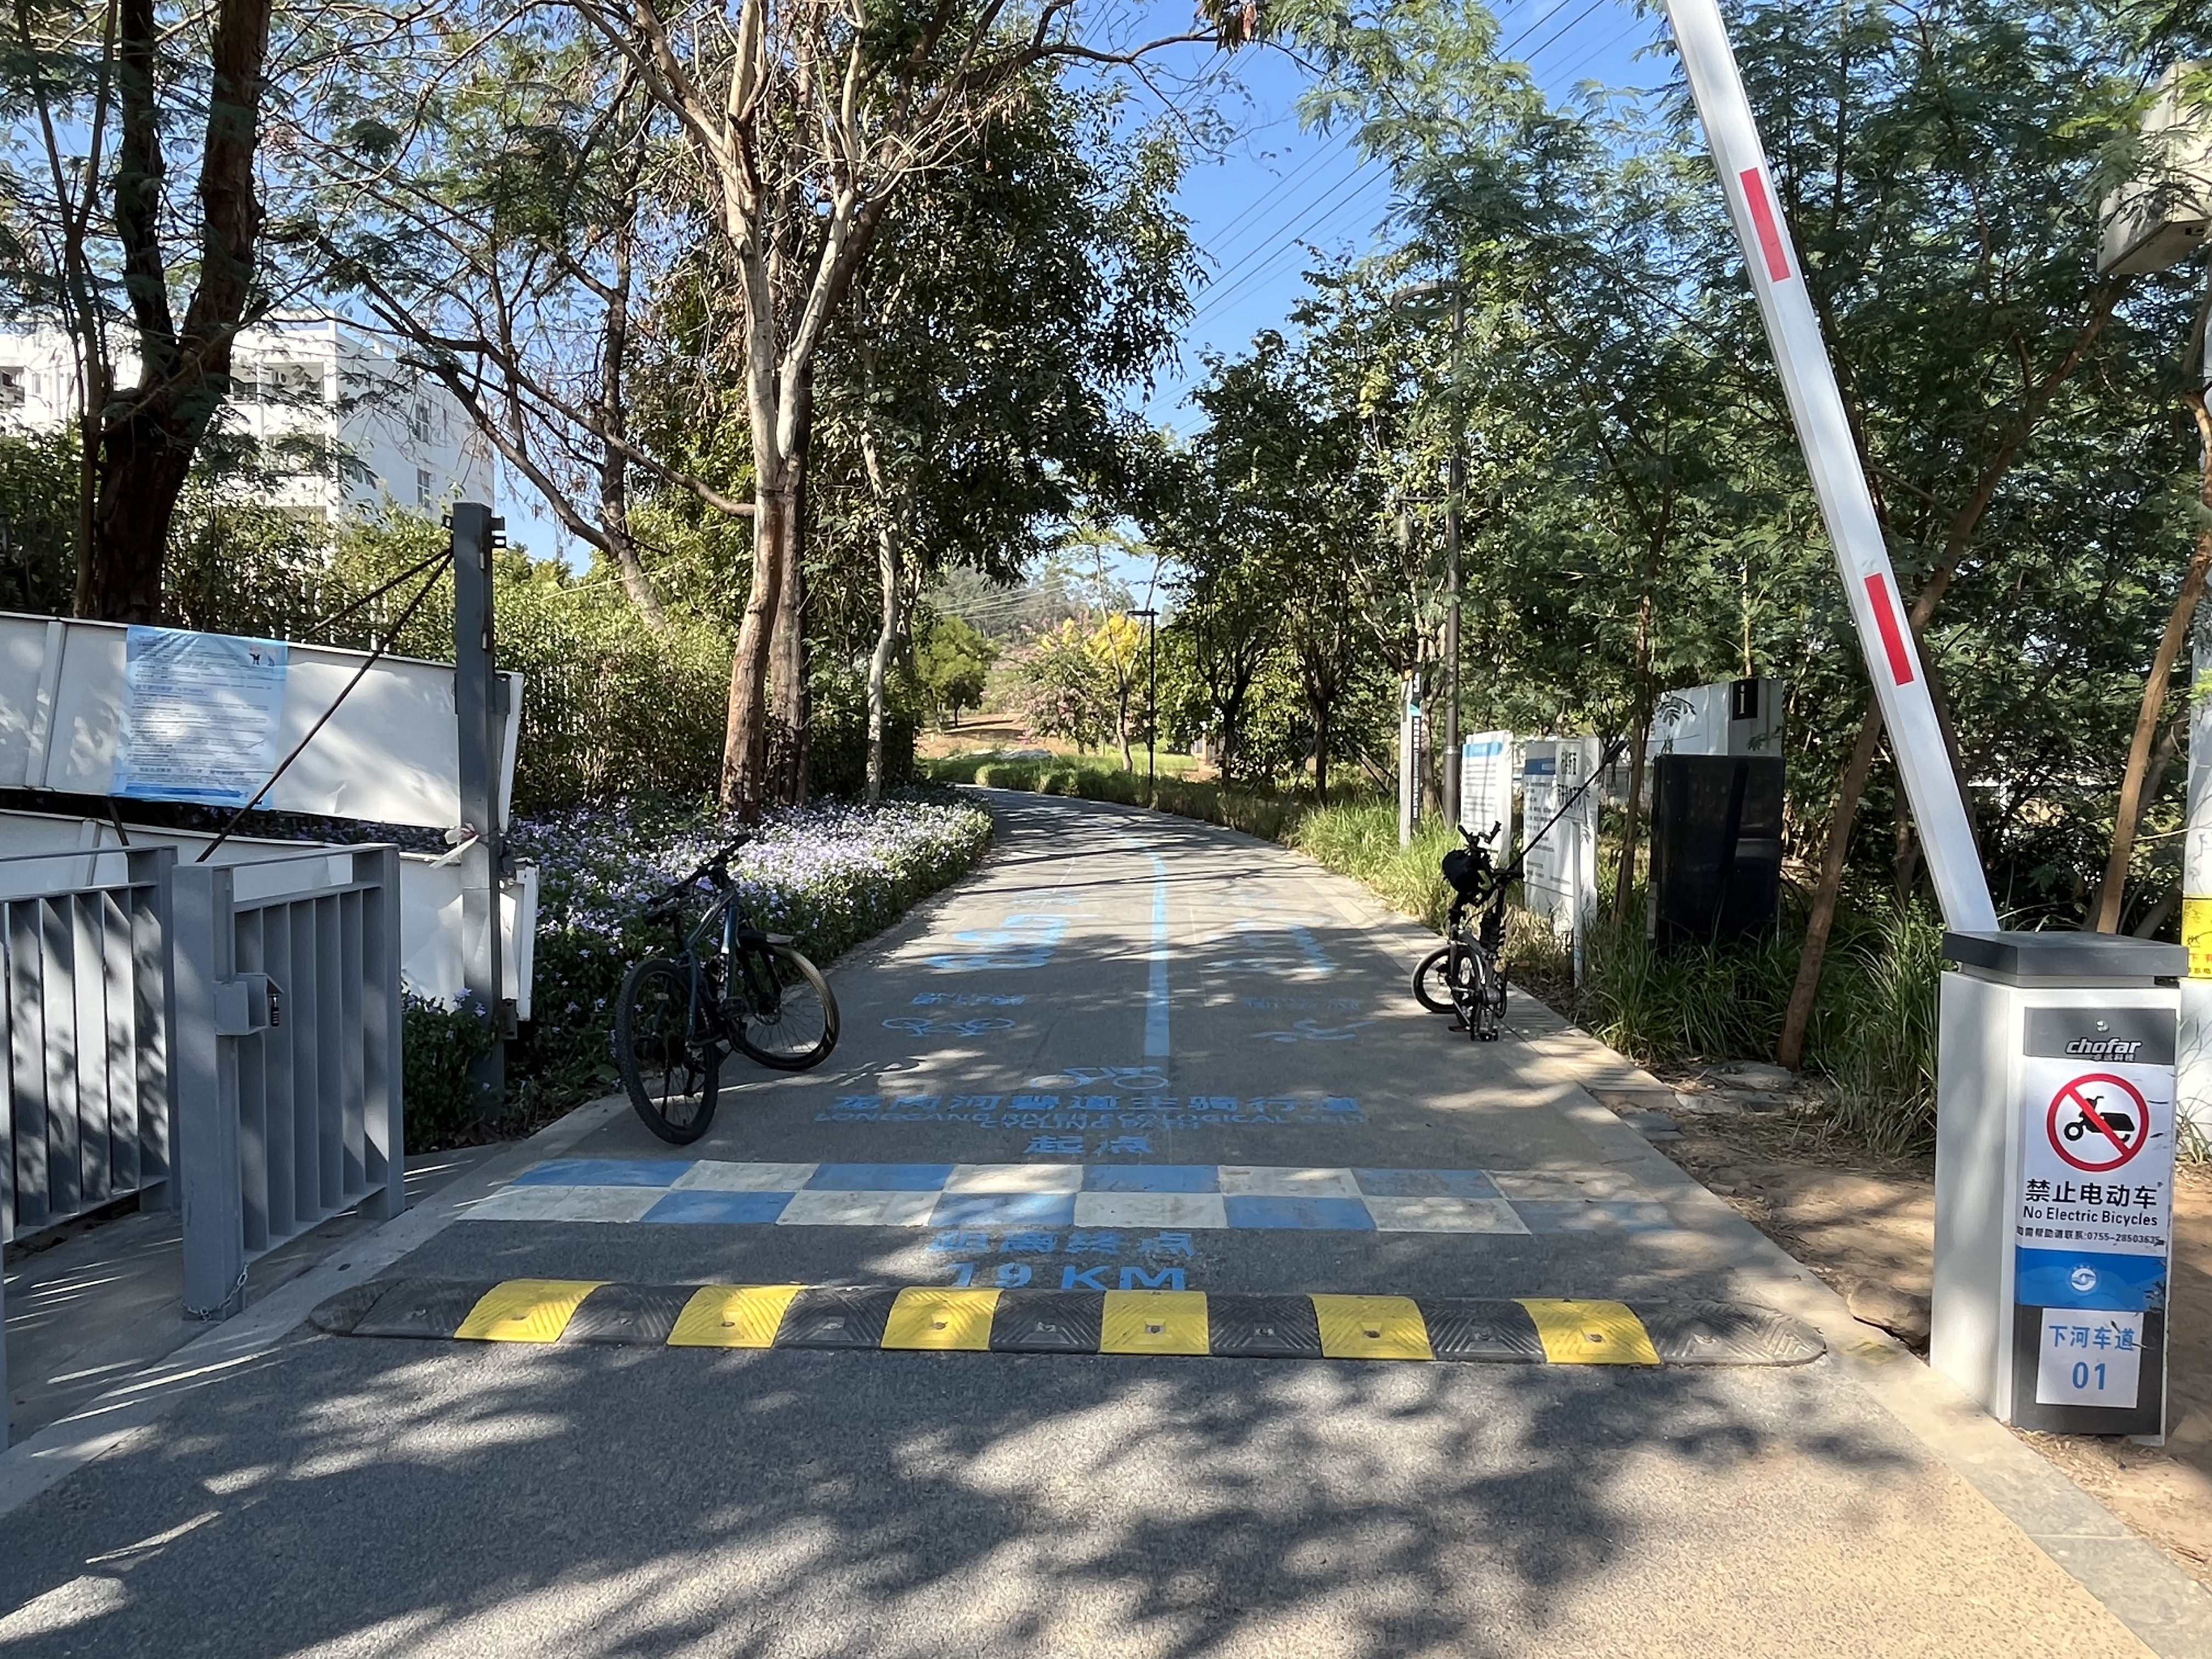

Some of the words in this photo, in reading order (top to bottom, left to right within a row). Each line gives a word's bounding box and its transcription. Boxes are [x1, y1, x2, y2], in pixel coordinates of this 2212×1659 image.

[2066, 1037, 2142, 1053] chofar
[1024, 1135, 1153, 1155] 起点
[2025, 1178, 2157, 1209] 禁止电动车
[2023, 1205, 2042, 1219] No
[2046, 1207, 2098, 1222] Electric
[2102, 1210, 2158, 1227] Bicycles
[927, 1230, 1195, 1256] 距离终点
[1061, 1264, 1187, 1291] KM
[2049, 1325, 2135, 1352] 下河车道
[2072, 1361, 2107, 1390] 01
